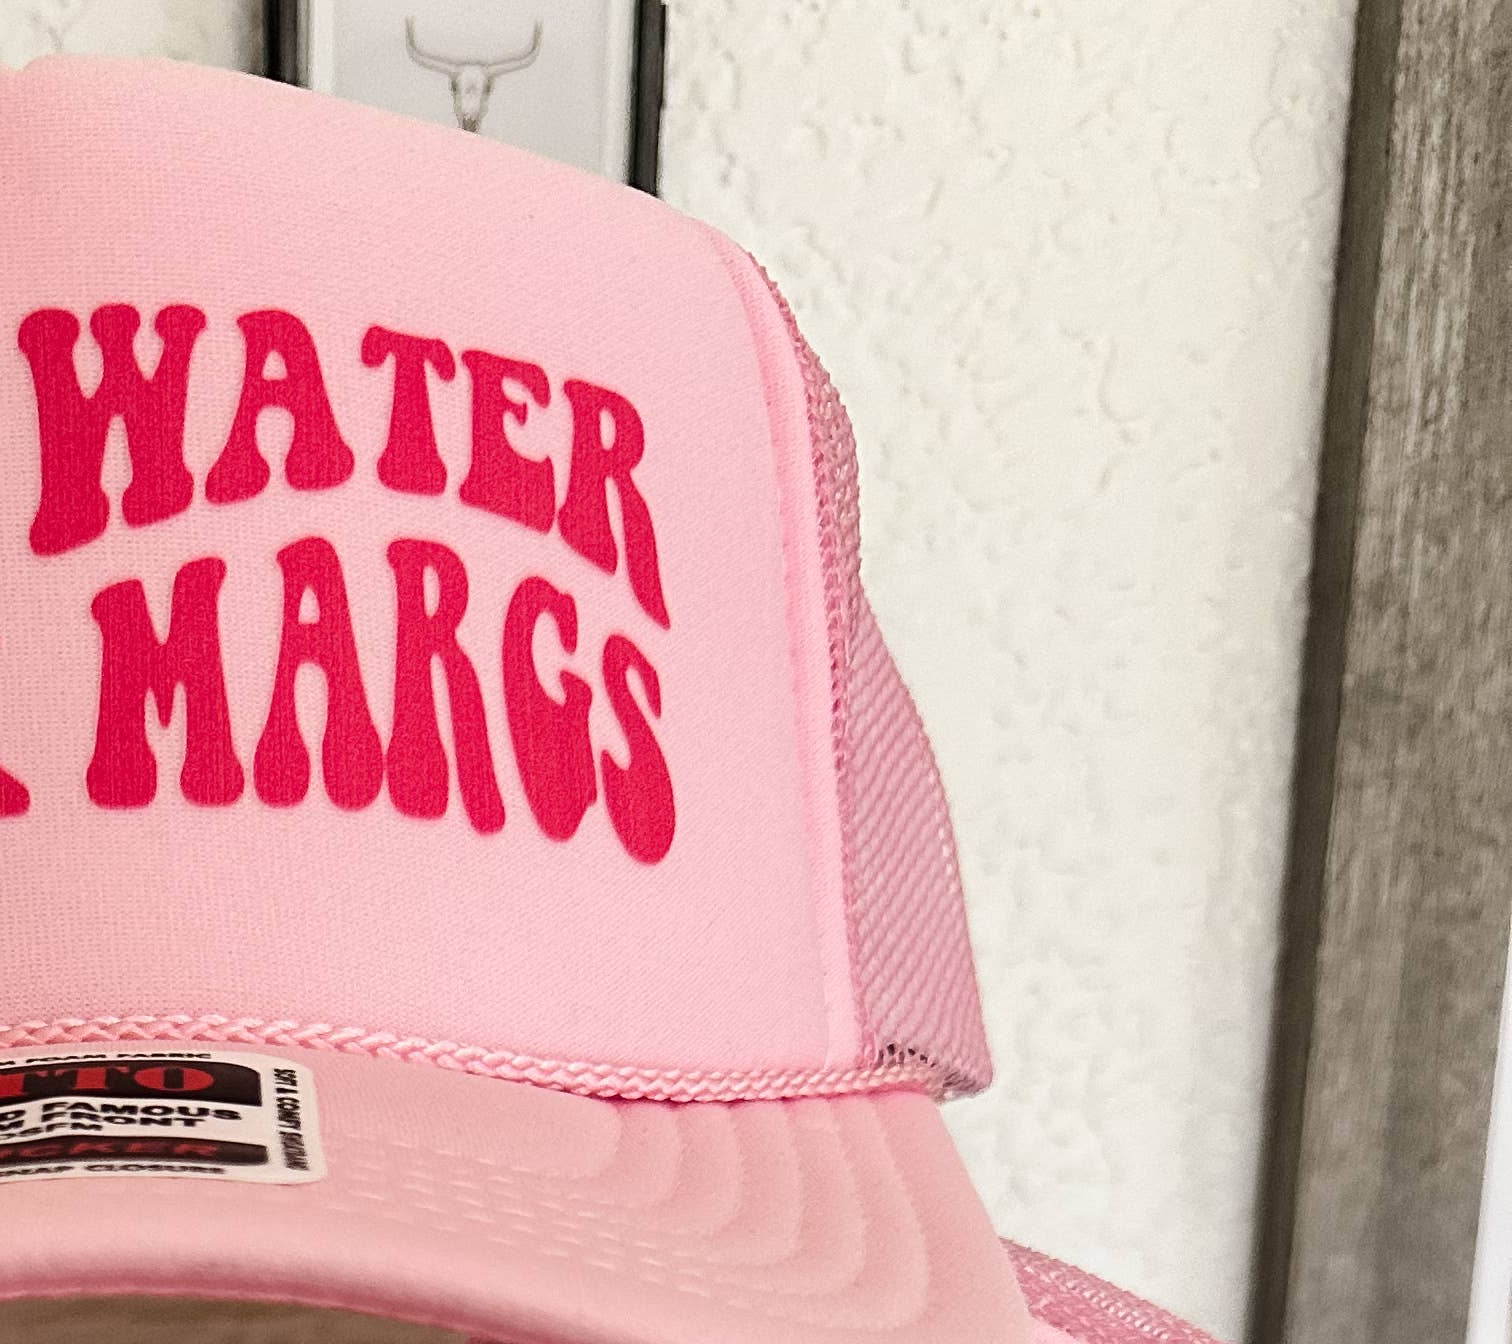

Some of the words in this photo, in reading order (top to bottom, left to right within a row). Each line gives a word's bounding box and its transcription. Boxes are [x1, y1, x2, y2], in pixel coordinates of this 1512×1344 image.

[18, 304, 670, 629] WATER
[87, 537, 676, 866] MARGS
[42, 1101, 242, 1121] FAMOUS
[42, 1112, 208, 1128] FRONT
